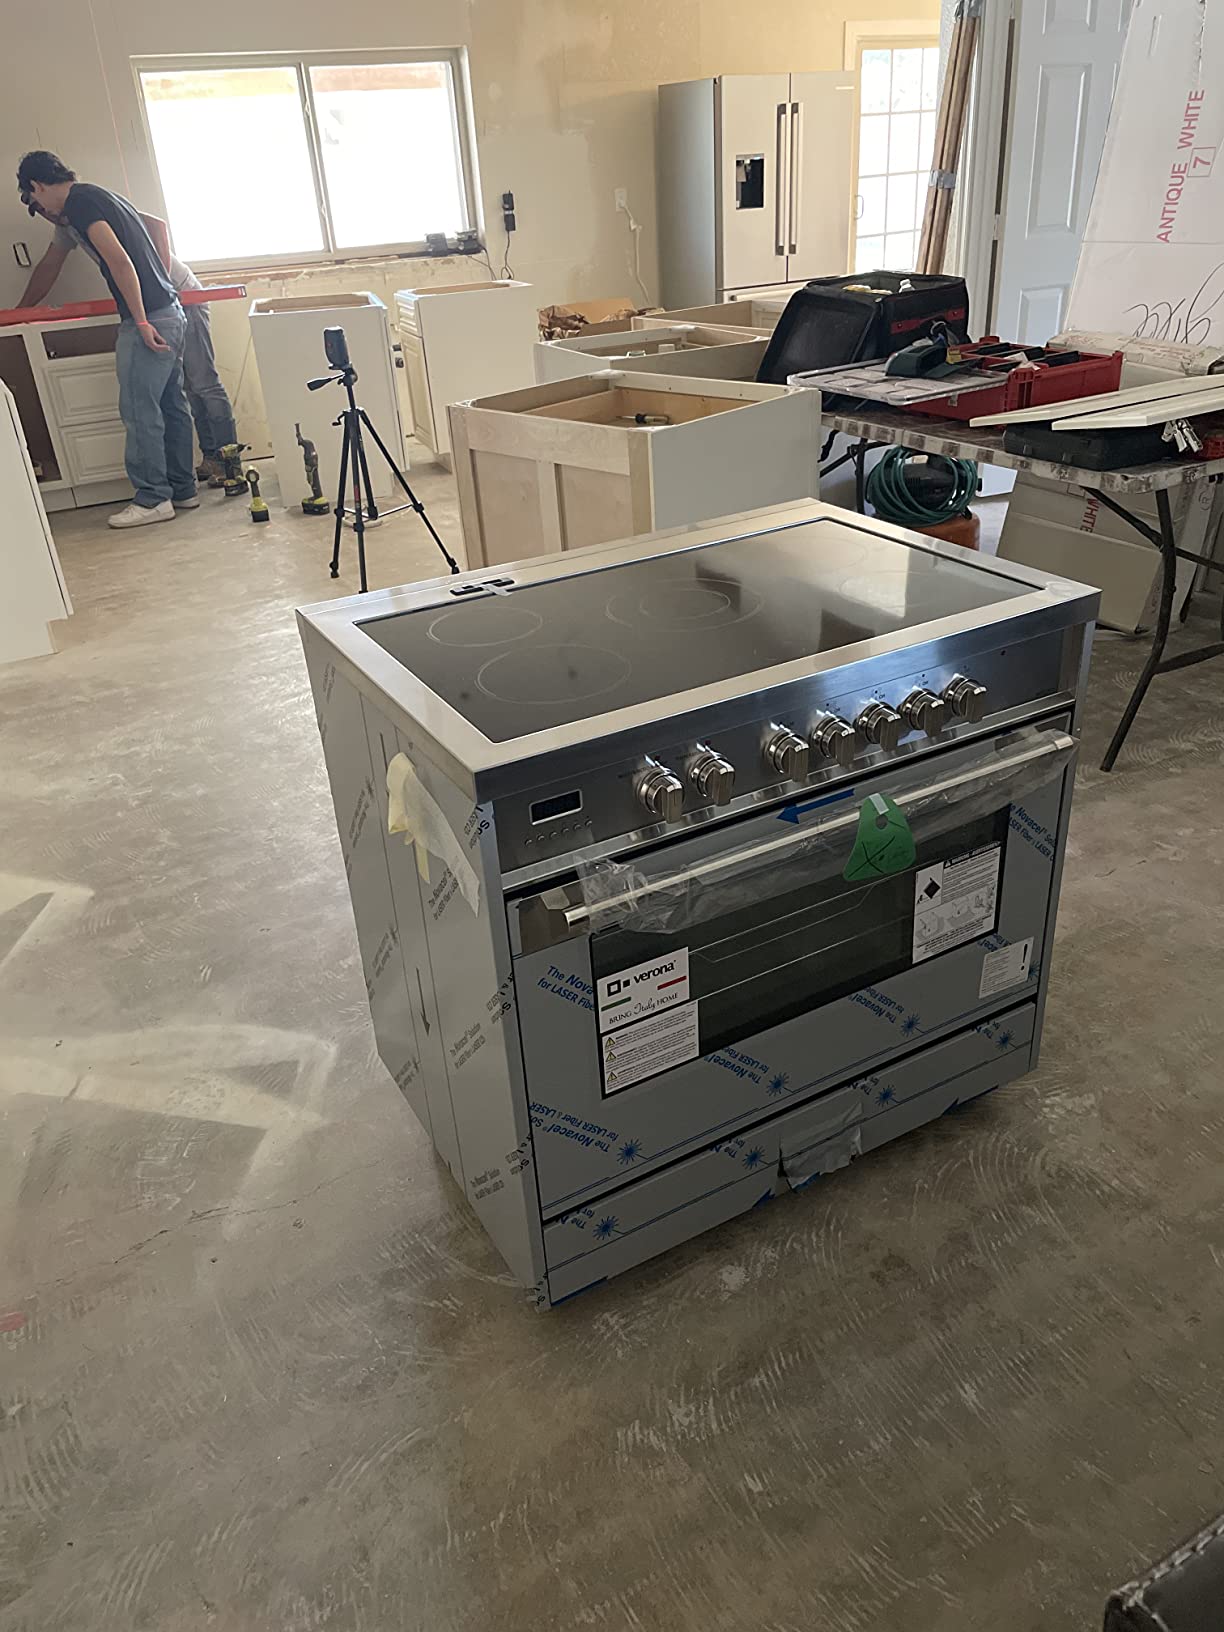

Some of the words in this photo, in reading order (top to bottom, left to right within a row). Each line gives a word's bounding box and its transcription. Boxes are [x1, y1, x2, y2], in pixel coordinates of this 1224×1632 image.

[1156, 162, 1189, 243] ANTIQUE
[1177, 89, 1205, 150] WHITE
[1192, 156, 1211, 169] 7
[547, 965, 565, 981] The
[633, 960, 676, 984] verona
[537, 977, 552, 990] for
[550, 984, 579, 1006] LASER
[608, 1011, 633, 1025] BRING
[656, 992, 678, 1007] HOME
[747, 1072, 762, 1084] The
[529, 1101, 557, 1118] LASER
[560, 1113, 583, 1129] Fiber
[582, 1121, 607, 1137] LASER
[605, 1132, 620, 1142] for
[595, 1139, 611, 1153] The
[571, 1216, 587, 1230] The
